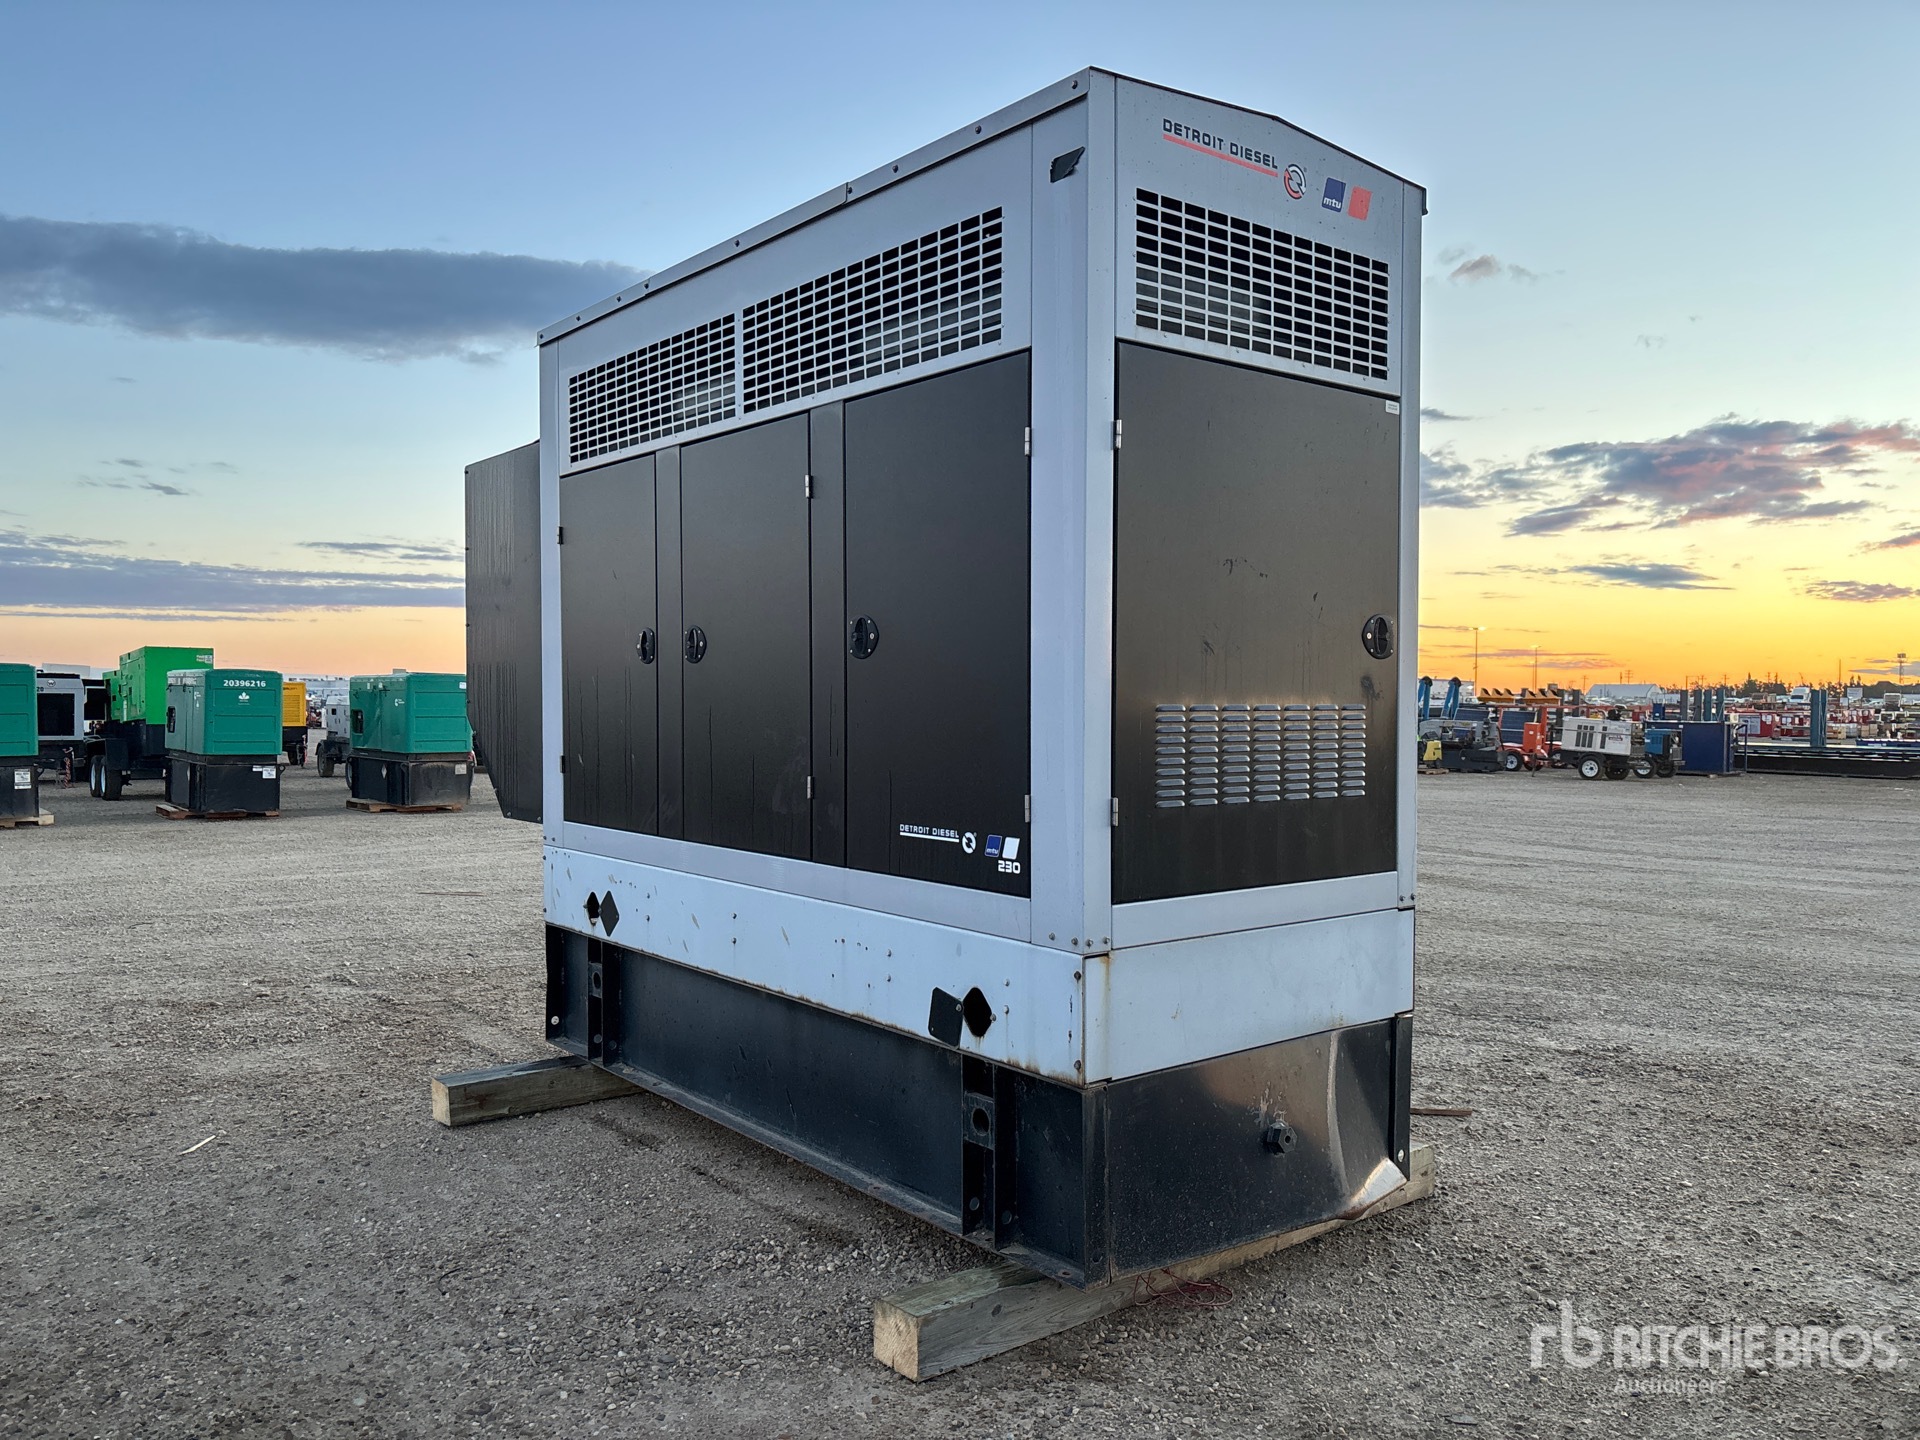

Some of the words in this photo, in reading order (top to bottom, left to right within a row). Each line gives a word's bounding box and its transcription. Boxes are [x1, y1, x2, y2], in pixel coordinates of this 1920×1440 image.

[1162, 118, 1224, 151] DETROIT
[1229, 142, 1279, 170] DIESEL
[1323, 196, 1342, 209] mtu
[223, 679, 267, 688] 20396216
[899, 823, 930, 835] DETROIT
[932, 827, 960, 838] DIESEL
[997, 859, 1021, 874] 230
